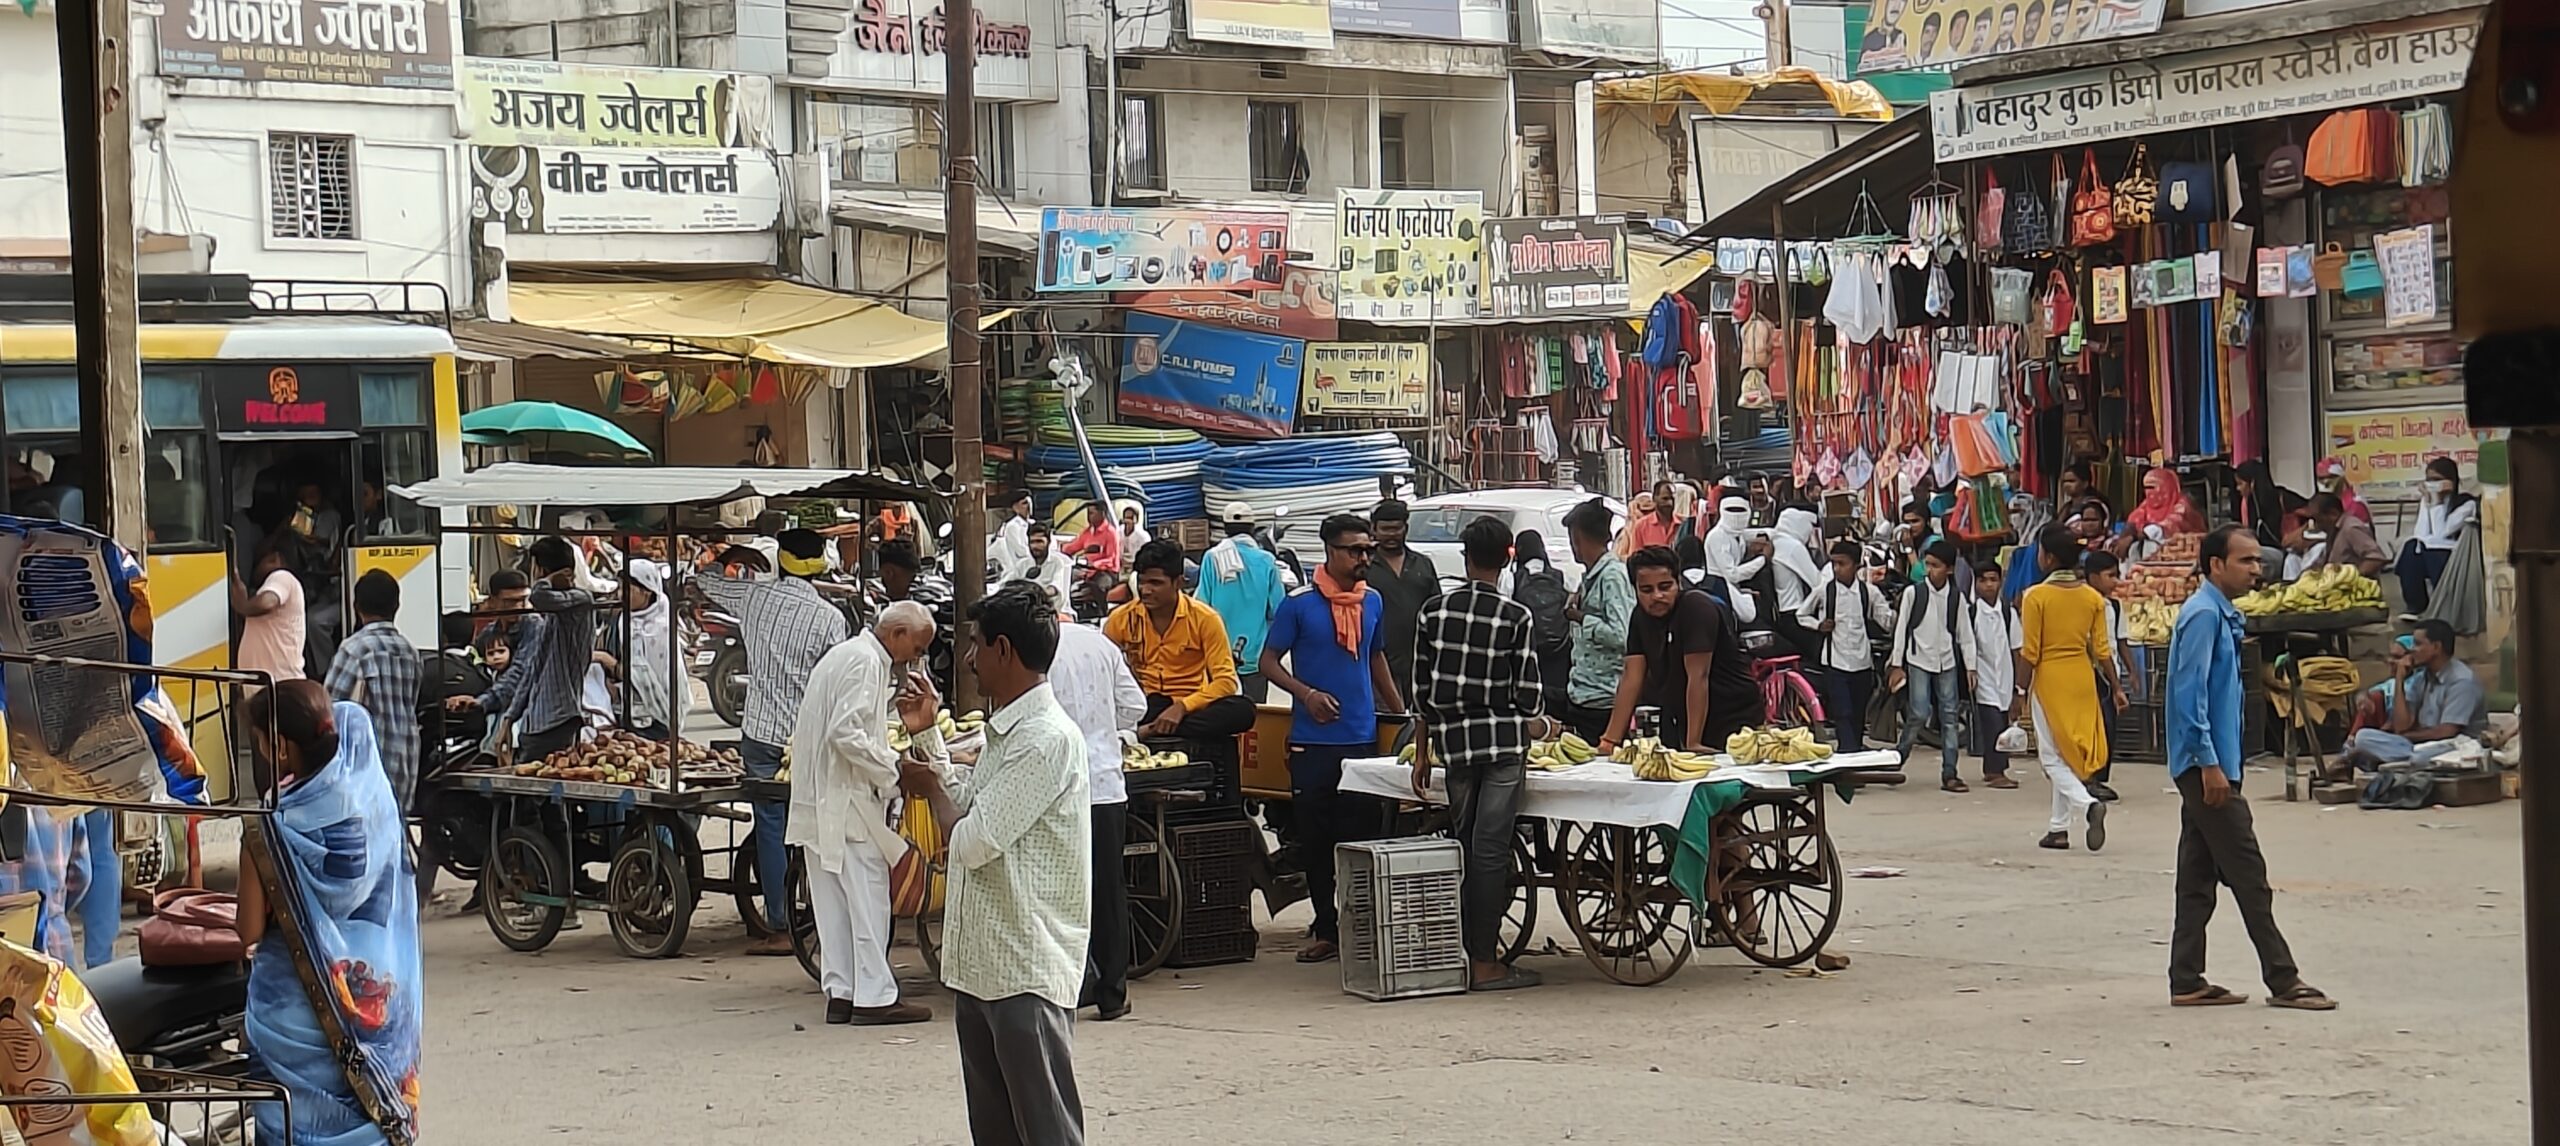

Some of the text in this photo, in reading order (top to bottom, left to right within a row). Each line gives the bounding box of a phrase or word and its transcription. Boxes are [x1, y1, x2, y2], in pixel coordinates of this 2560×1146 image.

[186, 0, 303, 46] आकाश
[854, 0, 912, 54] जैन
[1224, 24, 1250, 37] VIJAY
[1251, 27, 1275, 40] BOOT
[490, 82, 706, 137] अजय ज्वेलर्स
[1974, 90, 2052, 132] बहादुर
[2057, 82, 2103, 126] बुक
[2173, 55, 2263, 101] जनरल
[544, 152, 738, 195] वीर ज्वेलर्स
[1343, 198, 1453, 249] विजय फुटवेयर
[1193, 359, 1236, 378] PUMPS
[246, 400, 326, 424] WELCOME
